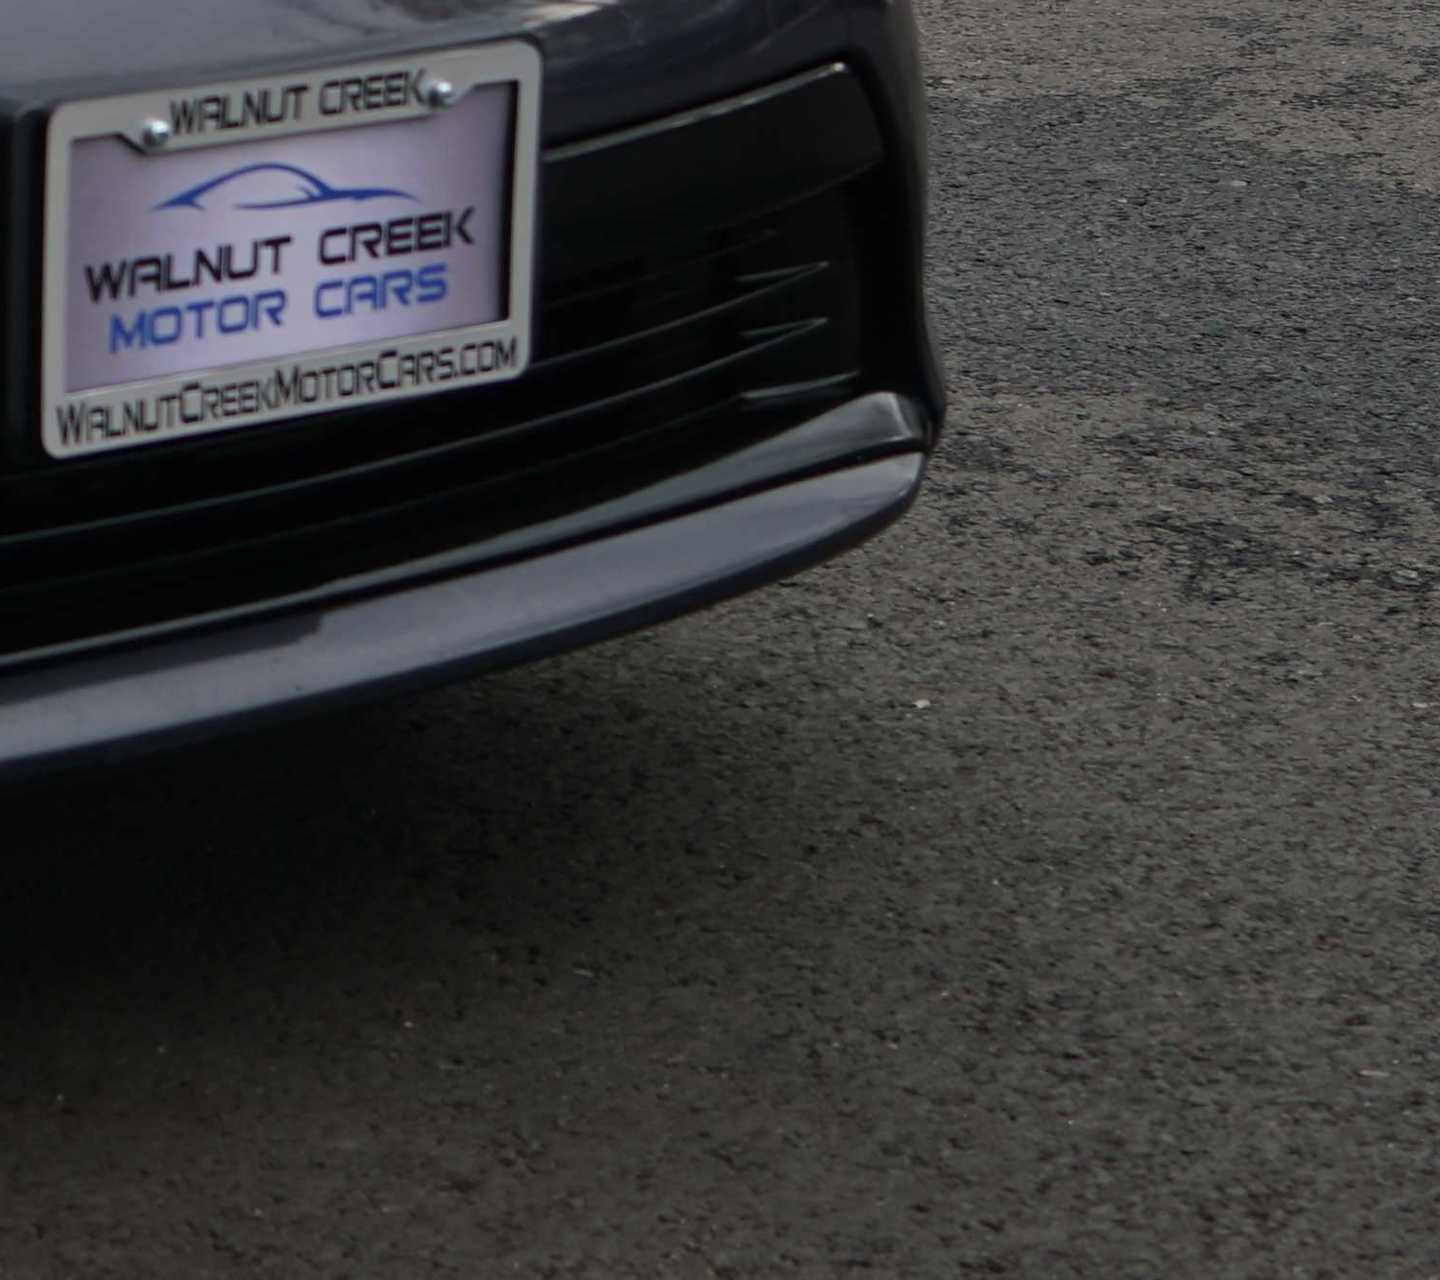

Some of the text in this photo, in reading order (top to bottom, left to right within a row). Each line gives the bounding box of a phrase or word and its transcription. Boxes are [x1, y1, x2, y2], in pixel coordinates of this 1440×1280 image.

[169, 69, 429, 137] WALNUT CREEK
[85, 207, 477, 304] WALNUT CREEK
[107, 264, 449, 354] MOTOR CARS
